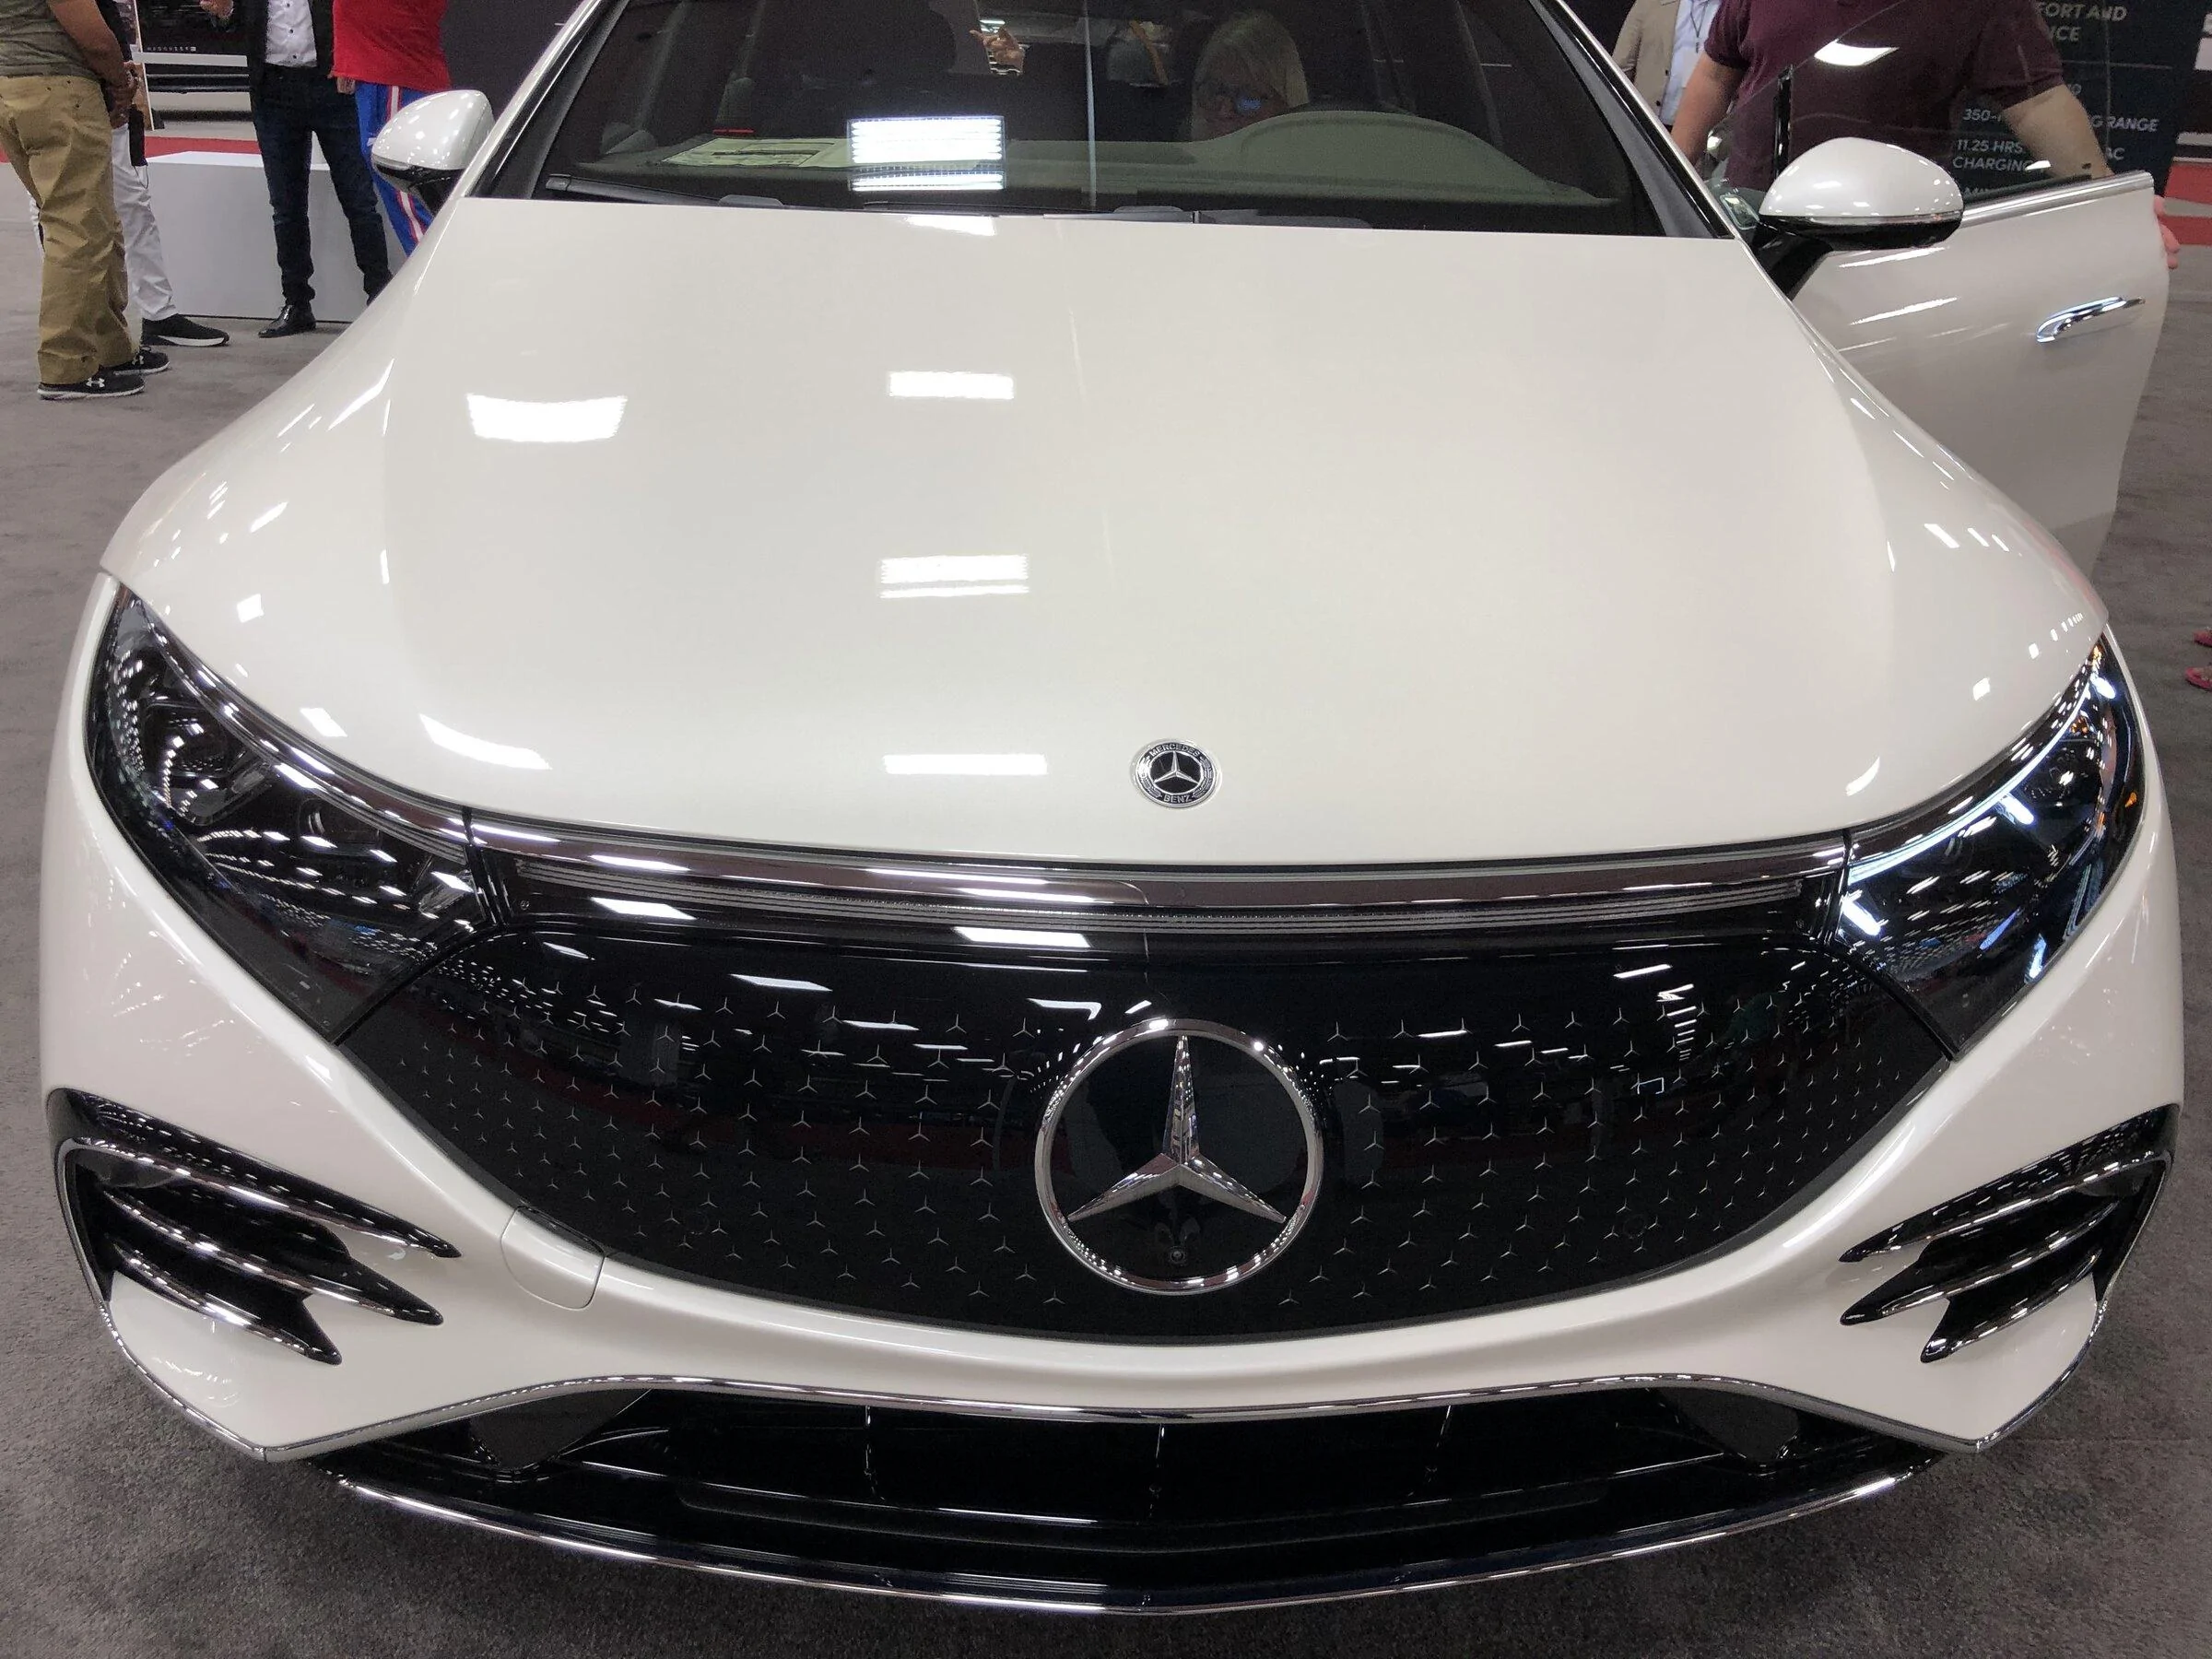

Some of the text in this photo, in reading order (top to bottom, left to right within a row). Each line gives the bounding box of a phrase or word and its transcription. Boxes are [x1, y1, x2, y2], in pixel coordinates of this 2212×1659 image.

[2086, 6, 2127, 21] AND
[2106, 116, 2159, 132] RANGE
[1957, 139, 1989, 152] 11.25
[1149, 743, 1200, 757] MERCEDES
[1163, 794, 1192, 804] BENZ
